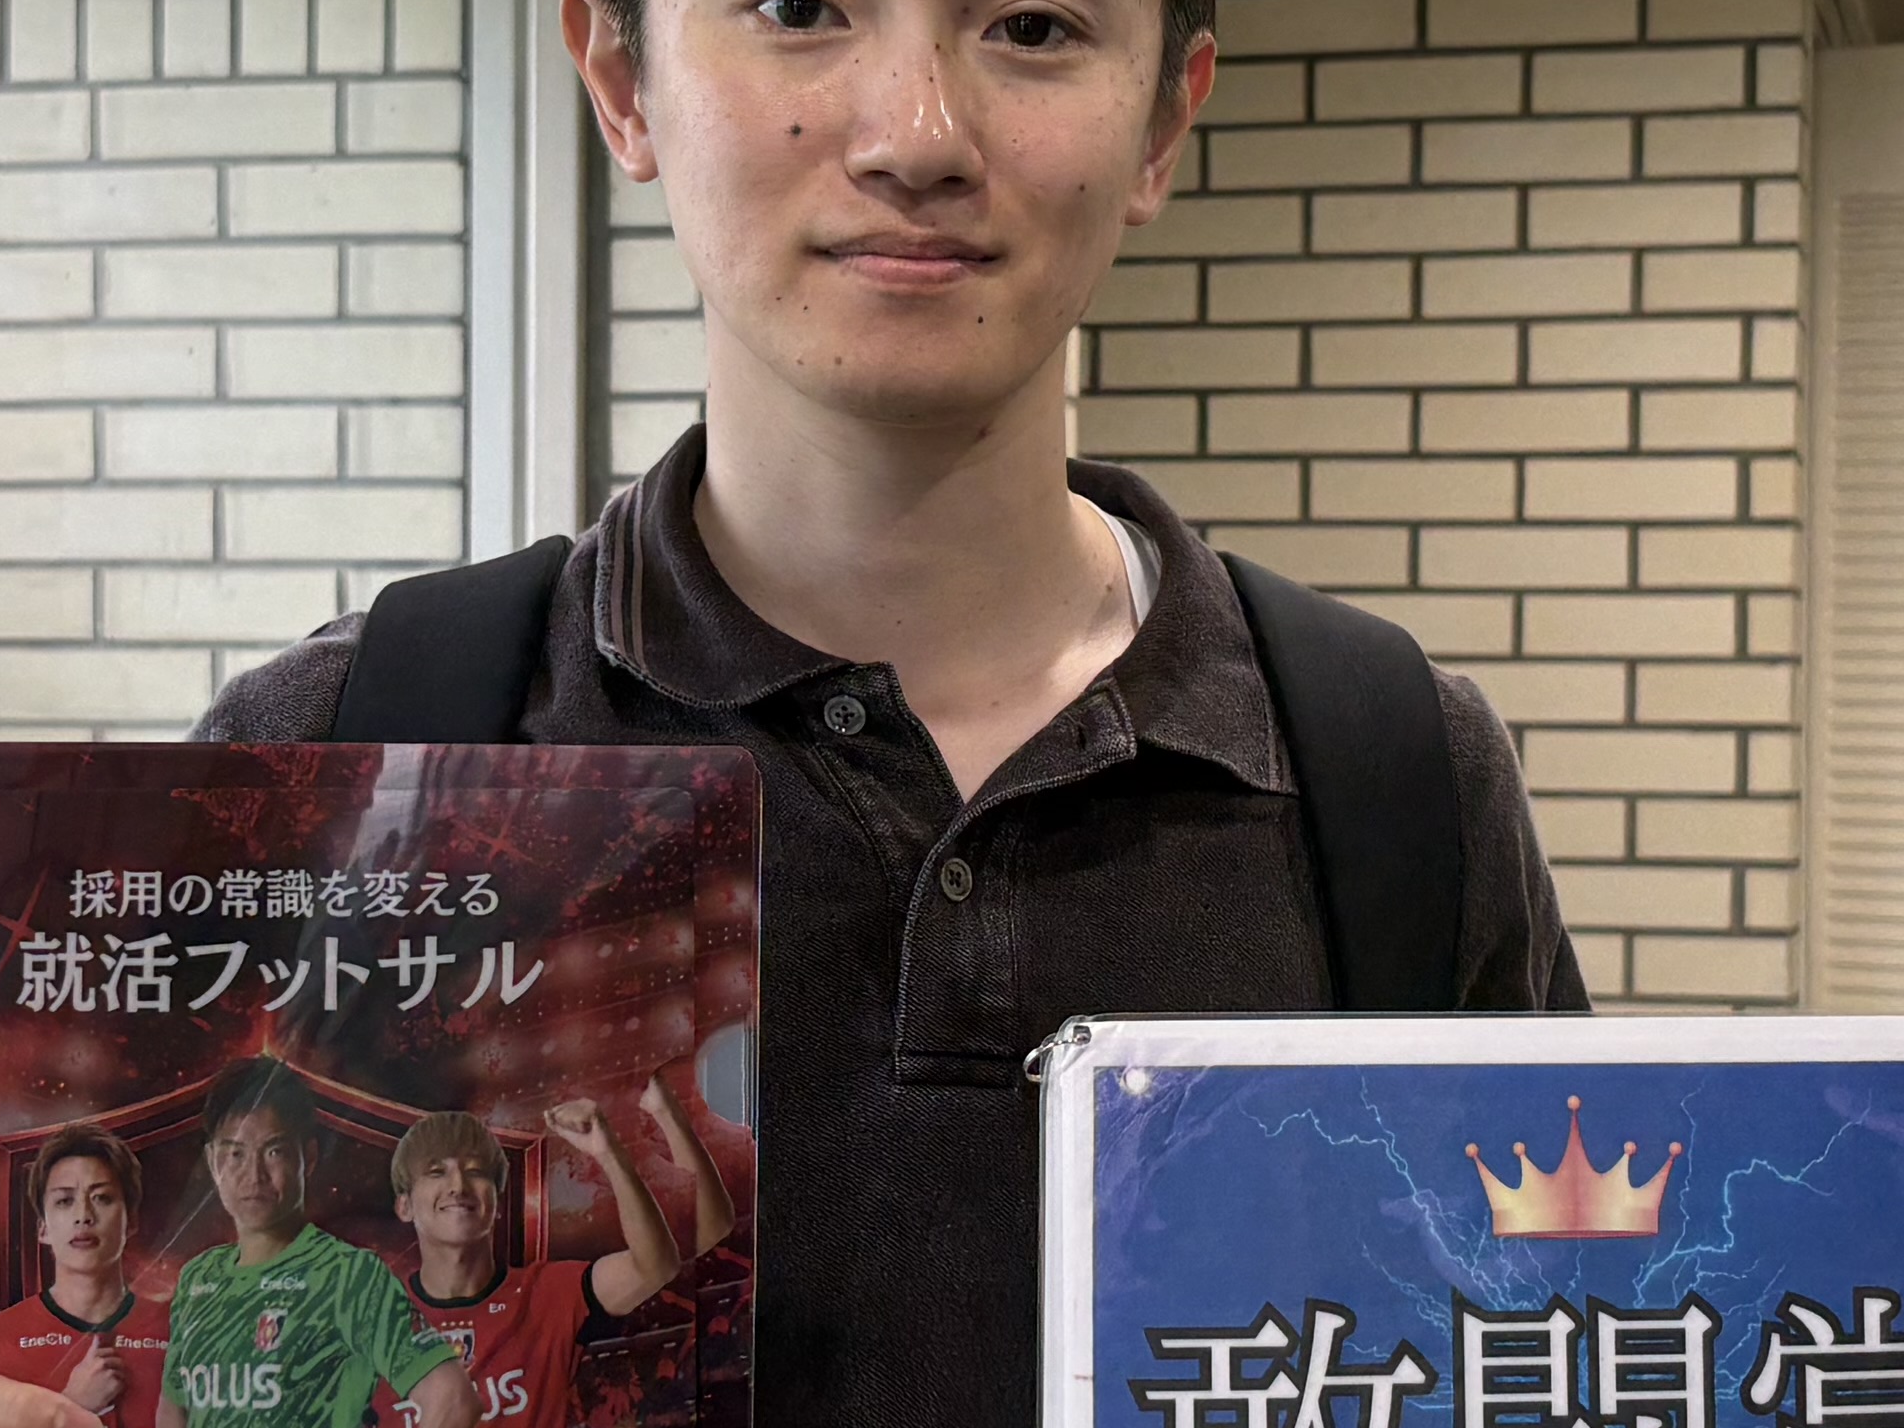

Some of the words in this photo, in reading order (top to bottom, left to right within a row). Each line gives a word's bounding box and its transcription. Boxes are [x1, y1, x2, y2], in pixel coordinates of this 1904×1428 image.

[68, 868, 500, 920] 採用の常識を変える
[15, 932, 545, 1014] 就活フットサル
[19, 1333, 73, 1349] EneCle
